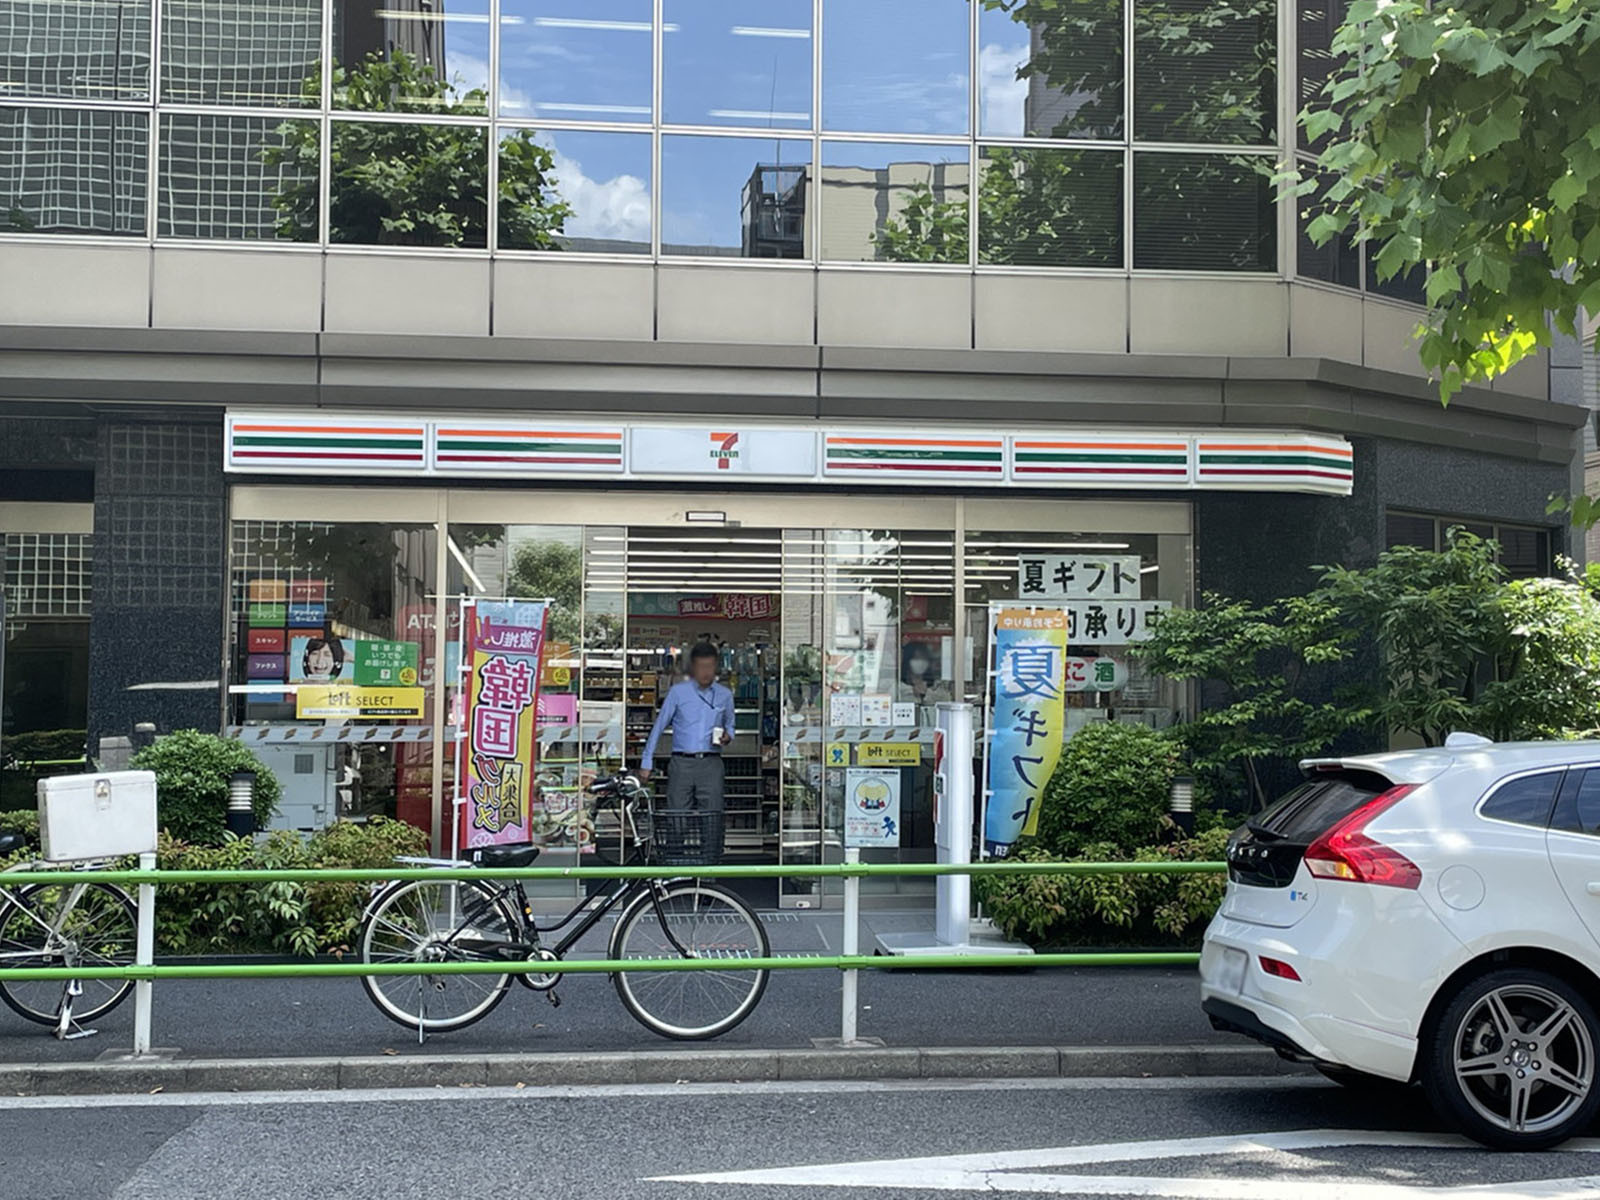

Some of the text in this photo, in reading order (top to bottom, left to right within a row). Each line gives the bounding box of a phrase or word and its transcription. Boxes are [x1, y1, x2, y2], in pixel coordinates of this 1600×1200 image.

[709, 431, 739, 469] 7
[1022, 559, 1136, 594] 夏ギフト
[255, 637, 278, 645] スキャン
[1094, 662, 1115, 682] 酒
[355, 695, 394, 706] SELECT
[885, 749, 911, 757] SELECT
